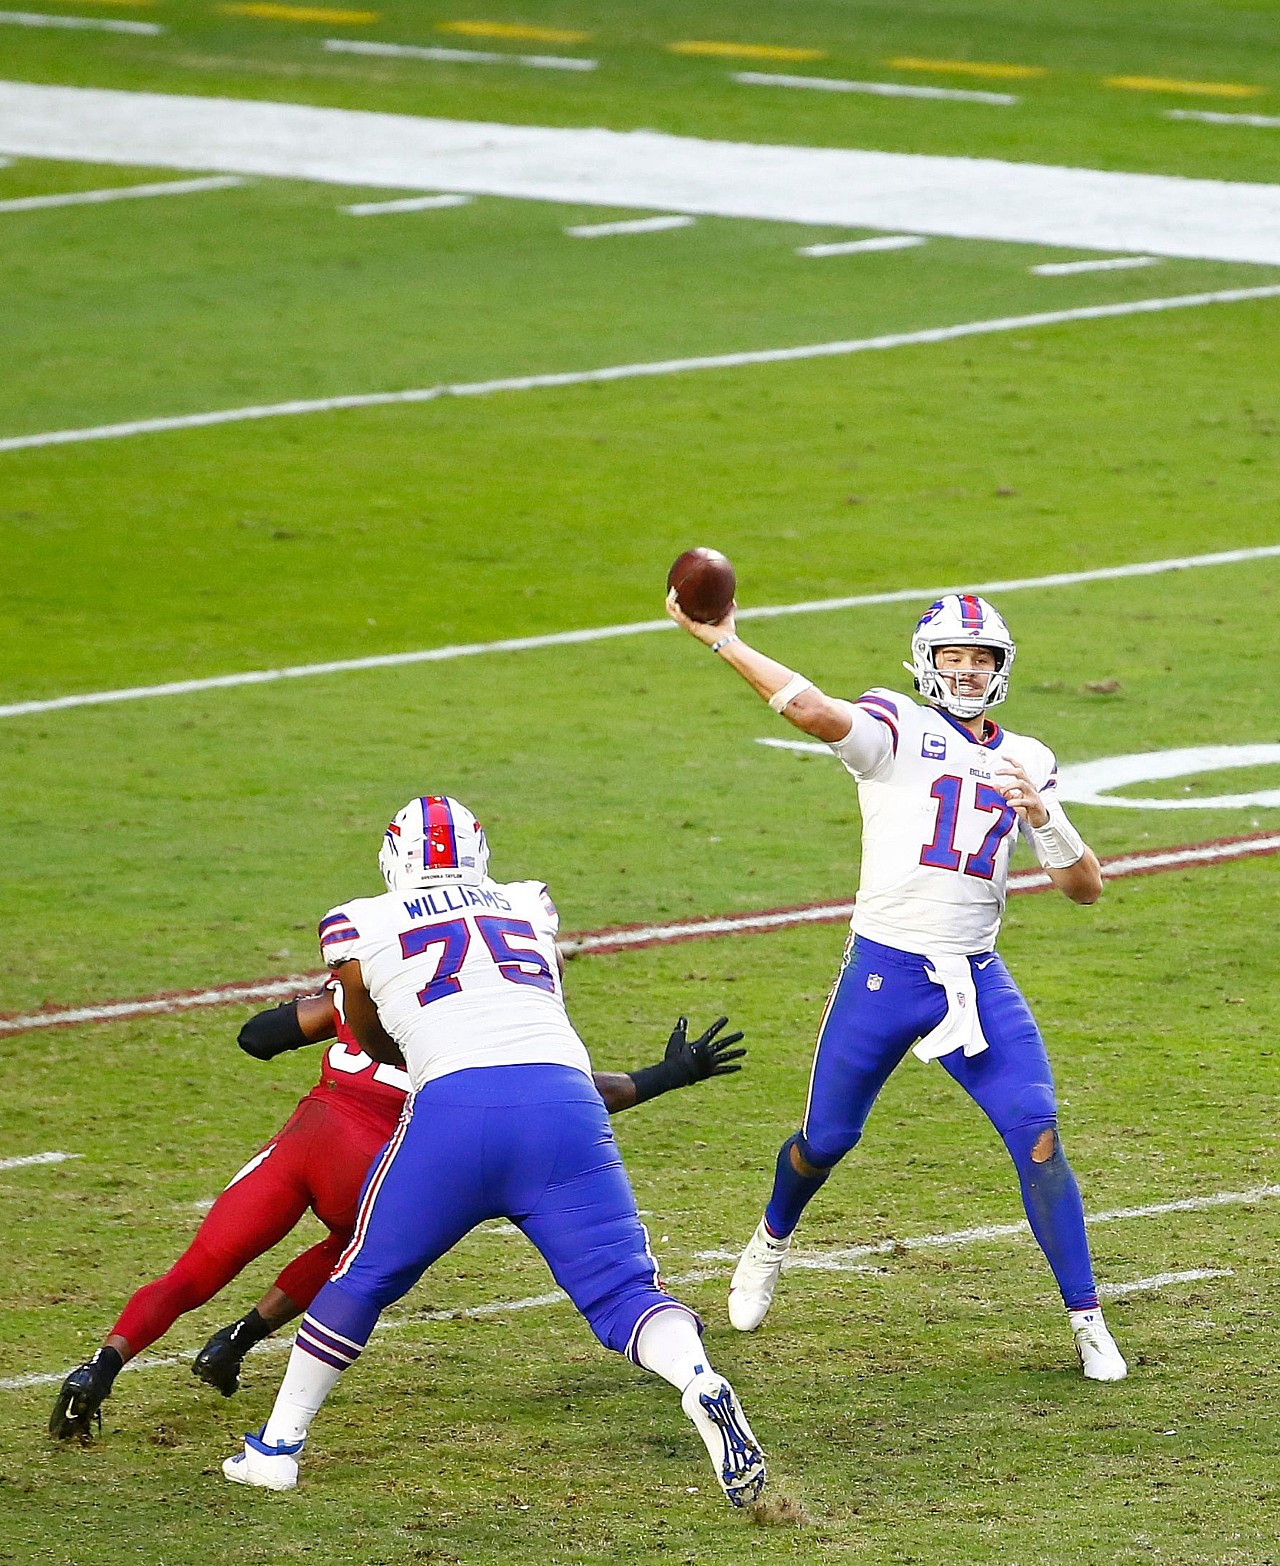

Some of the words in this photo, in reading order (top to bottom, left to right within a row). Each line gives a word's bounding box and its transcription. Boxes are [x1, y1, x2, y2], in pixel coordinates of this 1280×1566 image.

[923, 733, 946, 754] C
[969, 768, 991, 780] BILLS
[919, 774, 1017, 881] 17
[403, 886, 512, 920] WILLIAMS
[398, 915, 555, 1008] 75
